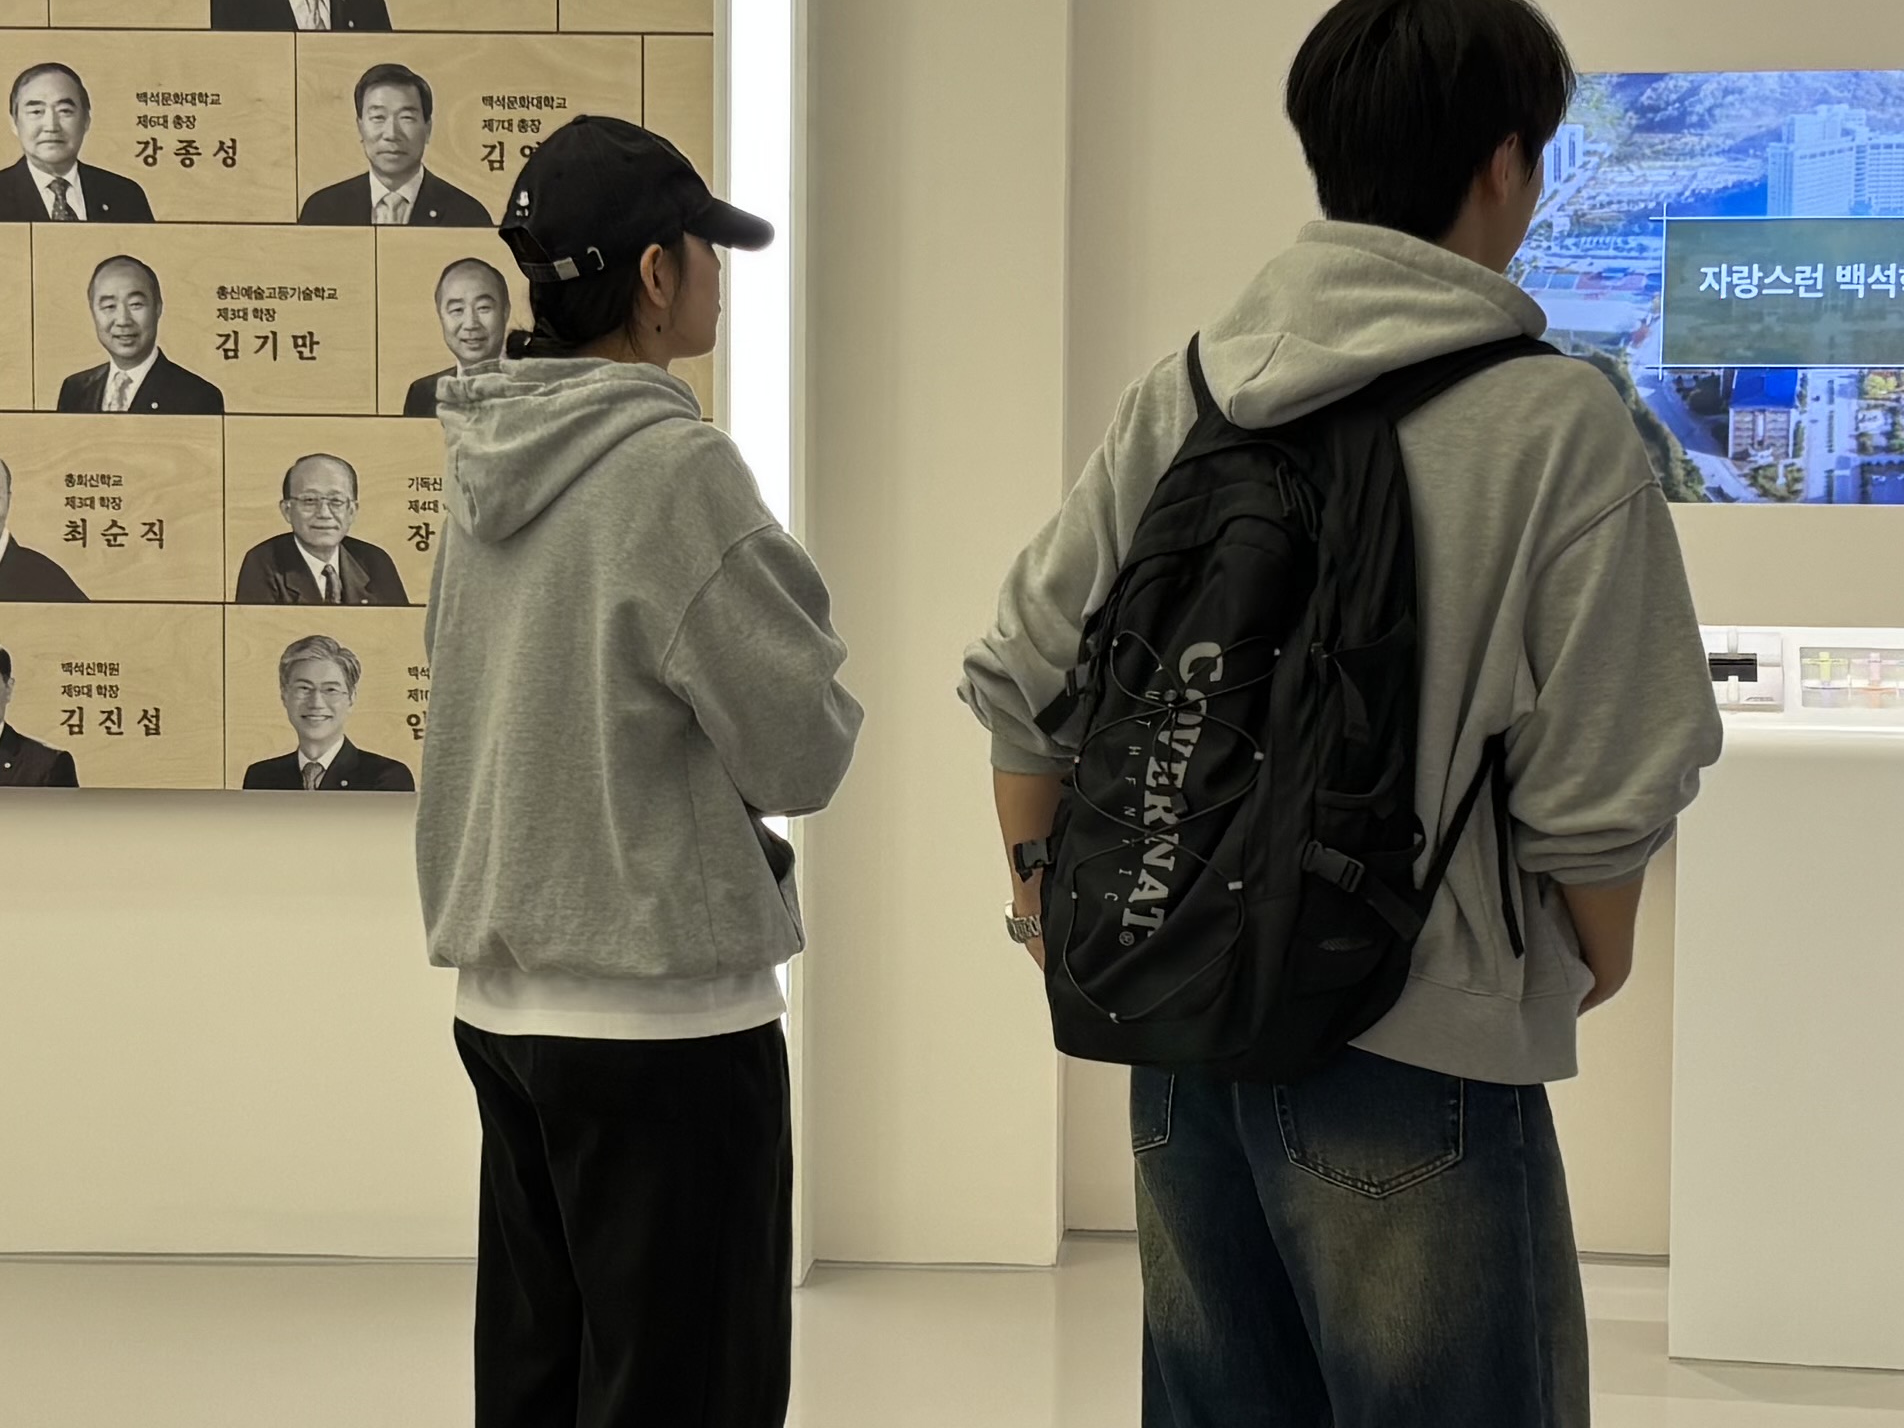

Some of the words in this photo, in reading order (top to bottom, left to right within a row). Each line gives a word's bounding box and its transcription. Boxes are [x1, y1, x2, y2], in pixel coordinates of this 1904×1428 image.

[135, 91, 222, 107] 백석문화대학교
[481, 95, 567, 110] 백석문화대학교
[135, 114, 169, 130] 제6대
[172, 114, 197, 130] 총장
[482, 118, 513, 133] 제7대
[517, 118, 542, 134] 총장
[134, 136, 237, 169] 강종성
[1698, 262, 1825, 300] 자랑스런
[215, 285, 339, 302] 총신예술고등기술학교
[216, 307, 249, 322] 제3대
[251, 307, 277, 323] 학장
[215, 329, 321, 362] 김기만
[64, 472, 124, 488] 총회신학교
[407, 476, 443, 492] 기독신
[64, 495, 96, 511] 제3대
[98, 496, 123, 511] 학장
[407, 499, 440, 514] 제4대
[62, 517, 164, 550] 최순직
[60, 661, 120, 677] 백석신학원
[60, 683, 93, 699] 제9대
[95, 684, 120, 699] 학장
[59, 705, 161, 737] 김진섭
